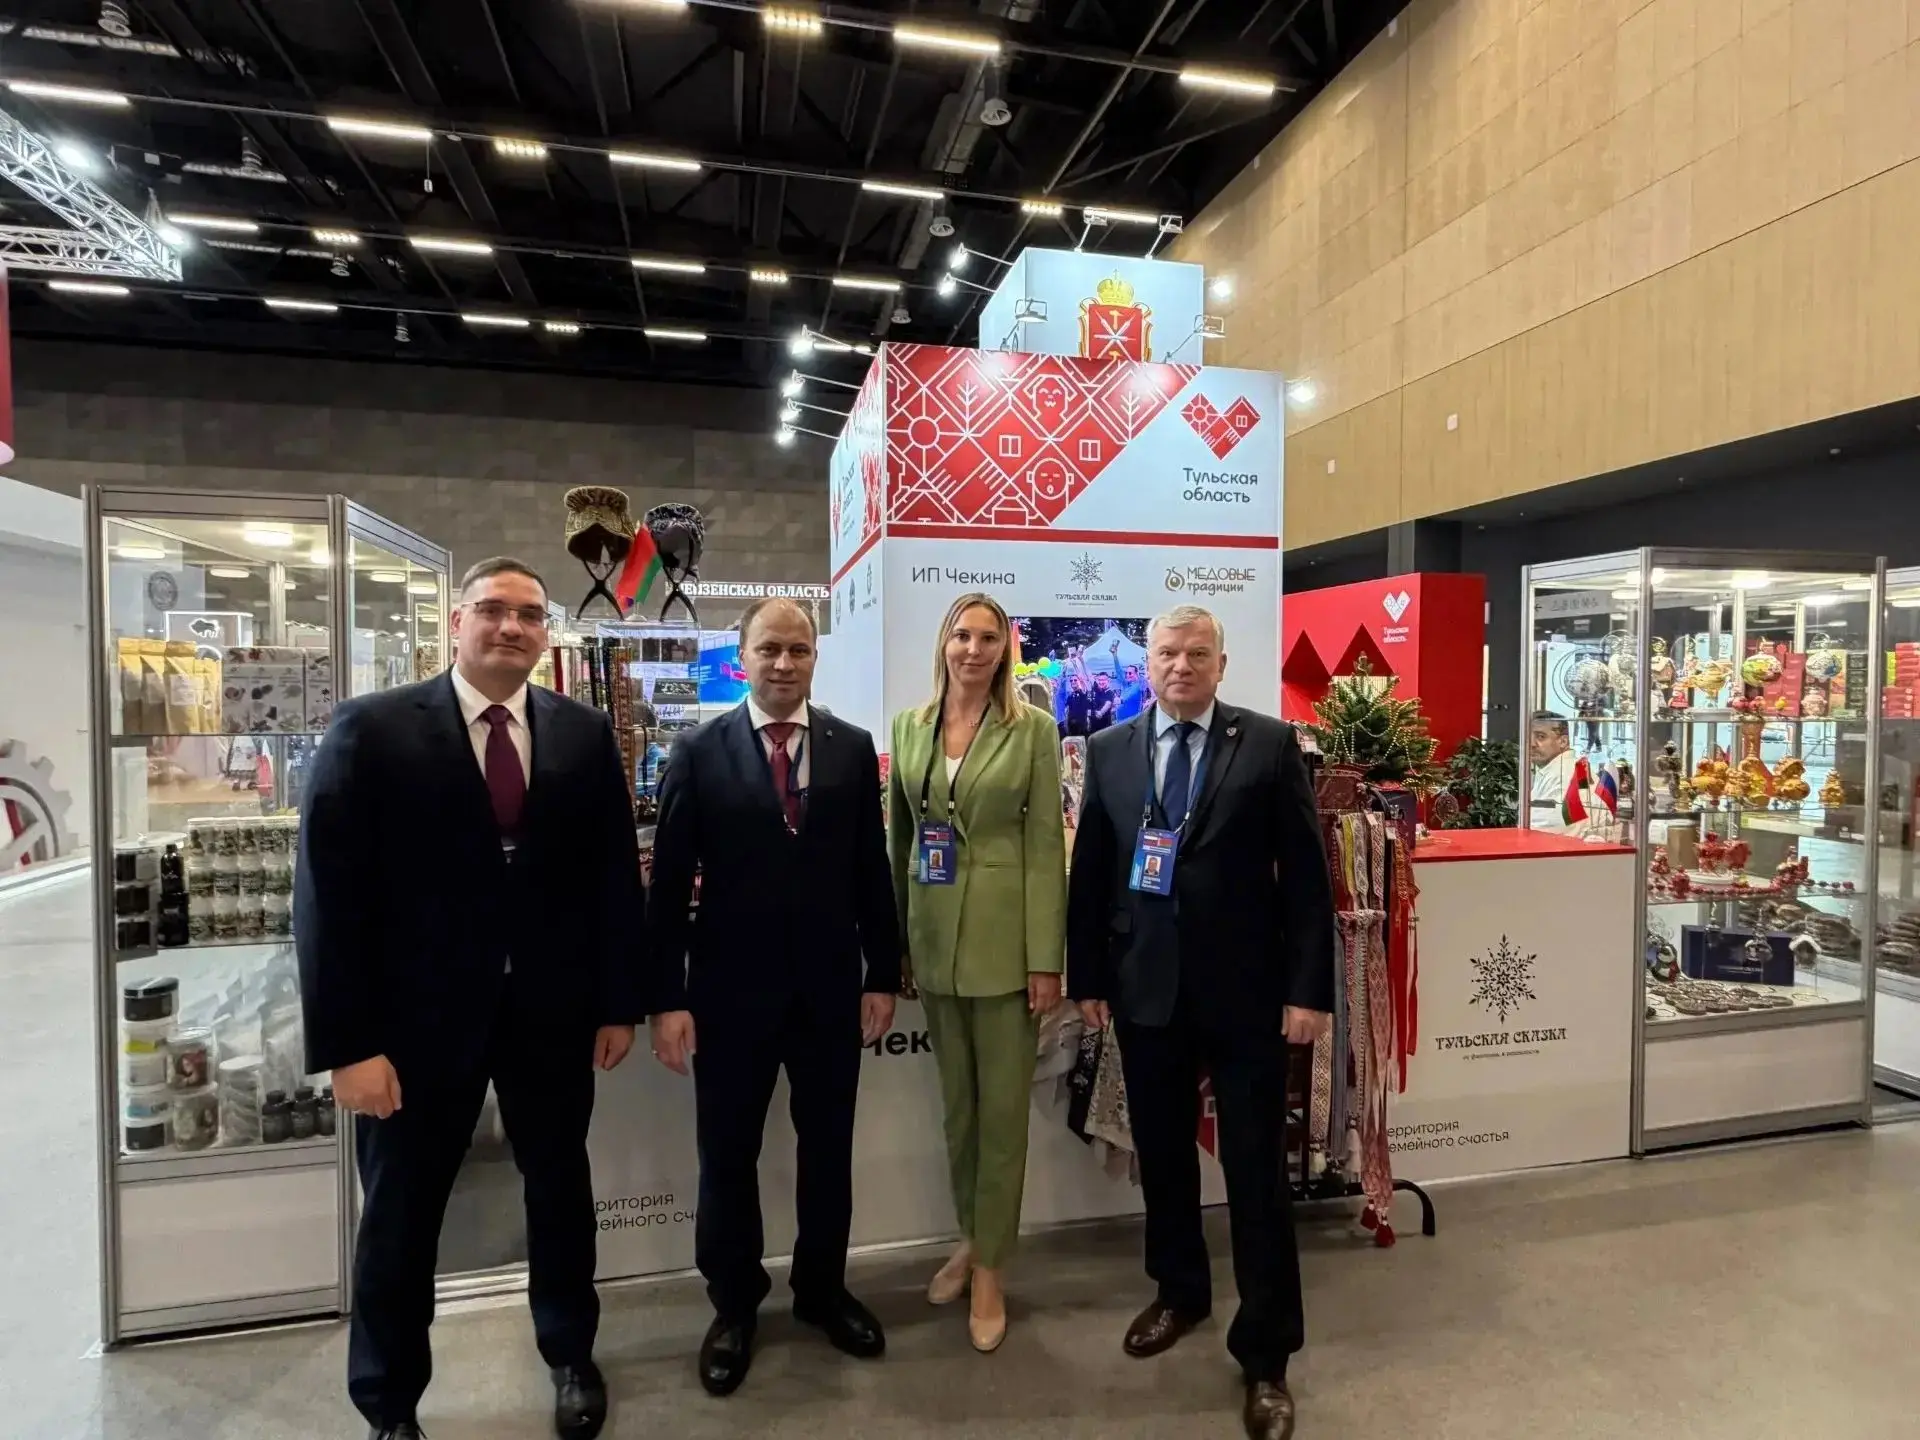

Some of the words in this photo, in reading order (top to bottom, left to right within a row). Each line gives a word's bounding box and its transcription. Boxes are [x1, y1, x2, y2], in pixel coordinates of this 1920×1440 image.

[1182, 467, 1258, 486] Тульская
[1183, 487, 1251, 503] область
[912, 567, 940, 583] ИП
[945, 567, 1016, 585] Чекина
[1187, 566, 1256, 582] МЕДОВЫЕ
[766, 585, 830, 598] ОБЛАСТЬ
[1187, 582, 1244, 596] традиции
[1434, 1032, 1510, 1050] ТУЛЬСКАЯ
[1513, 1028, 1567, 1044] СКАЗКА
[1387, 1121, 1460, 1138] ерритория
[1388, 1136, 1454, 1153] емейного
[1457, 1131, 1509, 1146] счастья
[595, 1193, 674, 1215] ритория
[600, 1213, 667, 1231] ейного
[673, 1211, 694, 1223] сч
